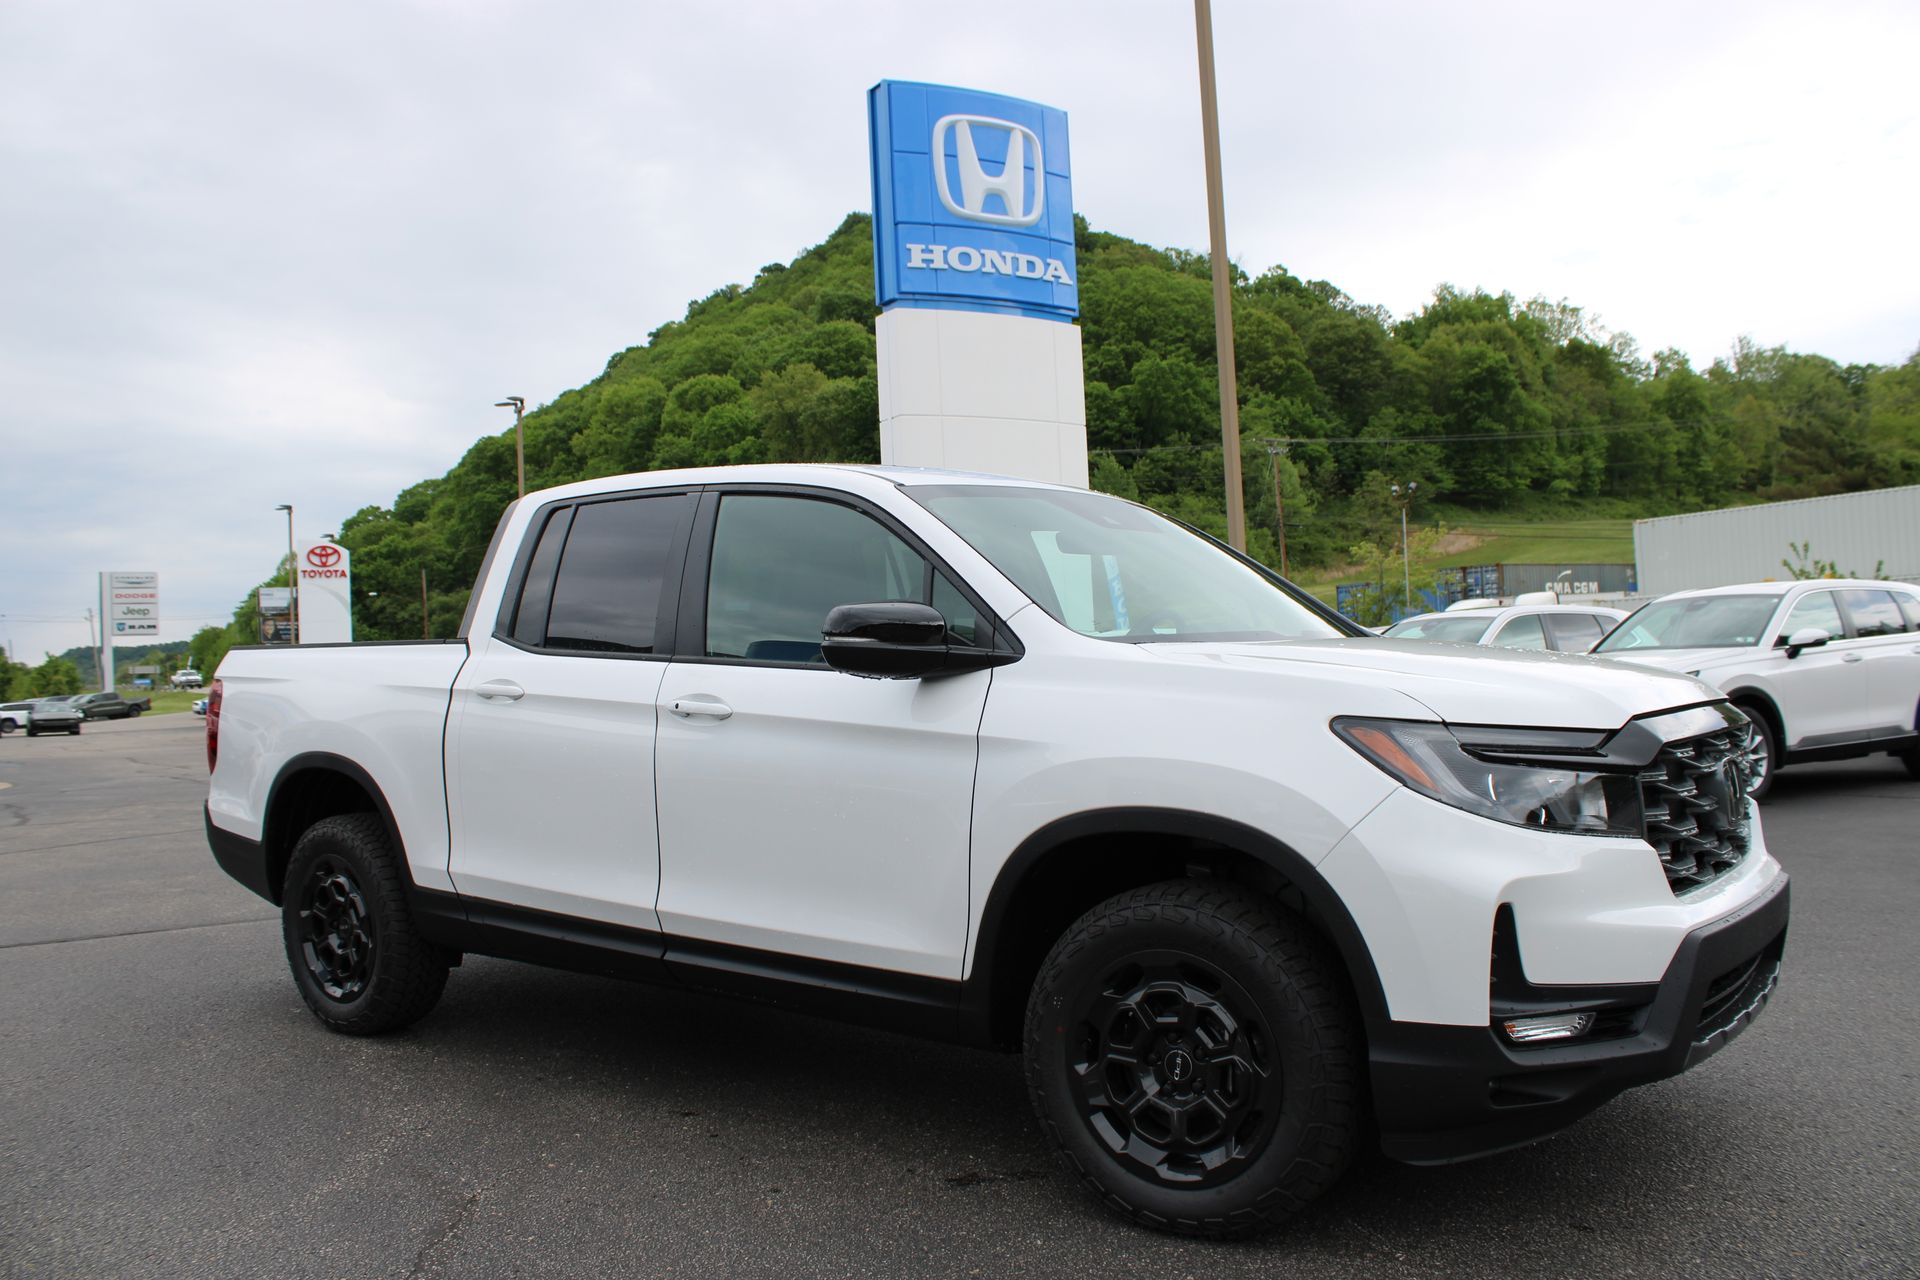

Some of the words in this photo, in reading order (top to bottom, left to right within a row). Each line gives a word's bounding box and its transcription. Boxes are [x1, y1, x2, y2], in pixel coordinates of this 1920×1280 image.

[906, 243, 1073, 285] HONDA
[301, 569, 347, 579] TOYOTA
[1545, 582, 1572, 594] CMA
[1573, 582, 1600, 594] CGM
[122, 606, 150, 616] Jeep
